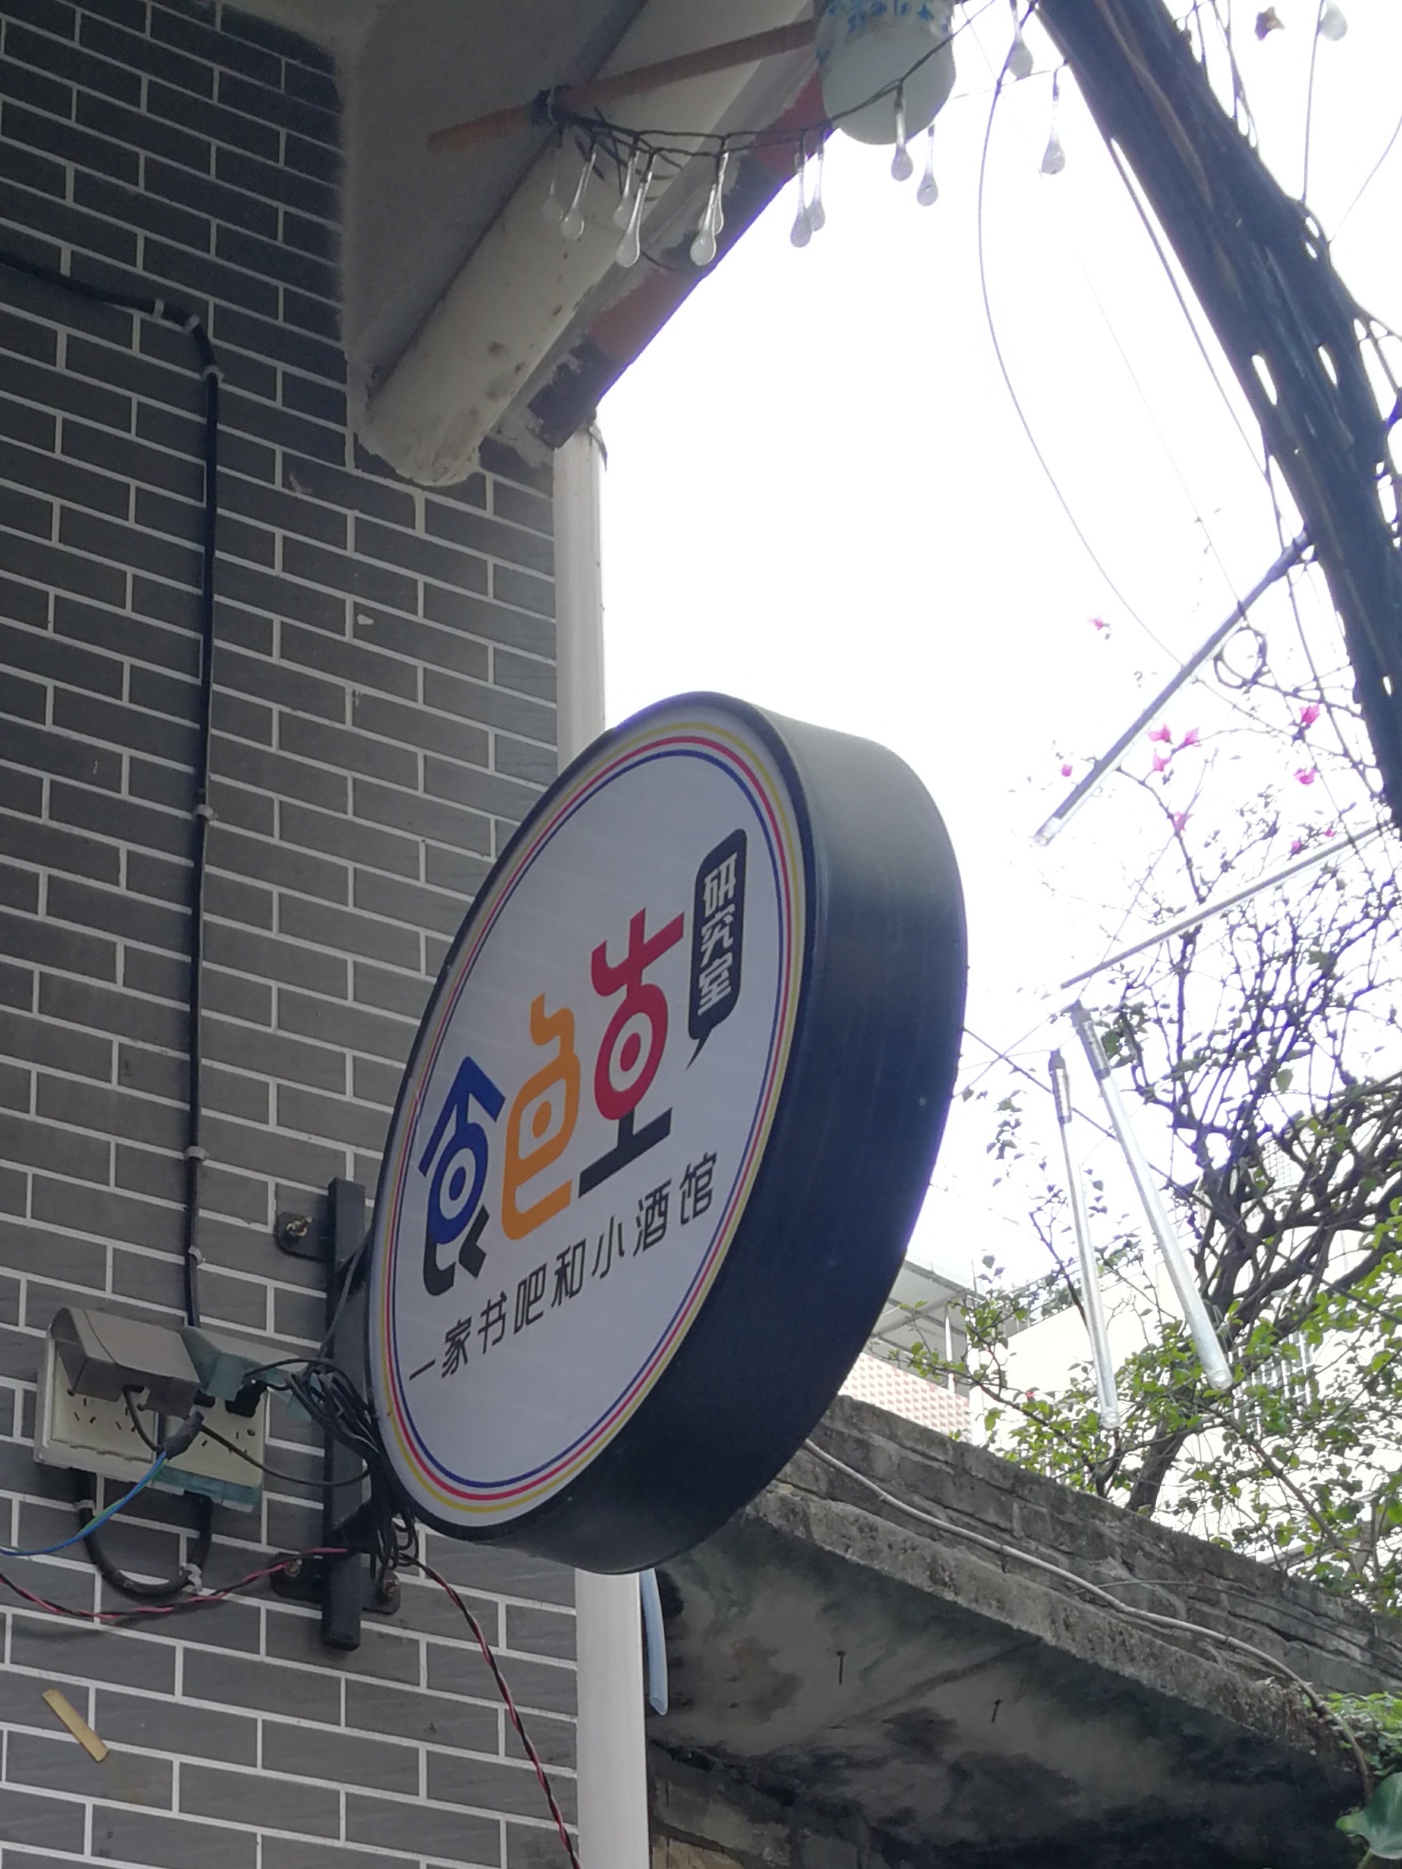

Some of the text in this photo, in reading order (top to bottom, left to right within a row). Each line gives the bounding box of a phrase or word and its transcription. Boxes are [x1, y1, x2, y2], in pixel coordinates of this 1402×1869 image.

[697, 852, 738, 1017] 研究室
[408, 1151, 717, 1383] 一家书吧和小酒馆
